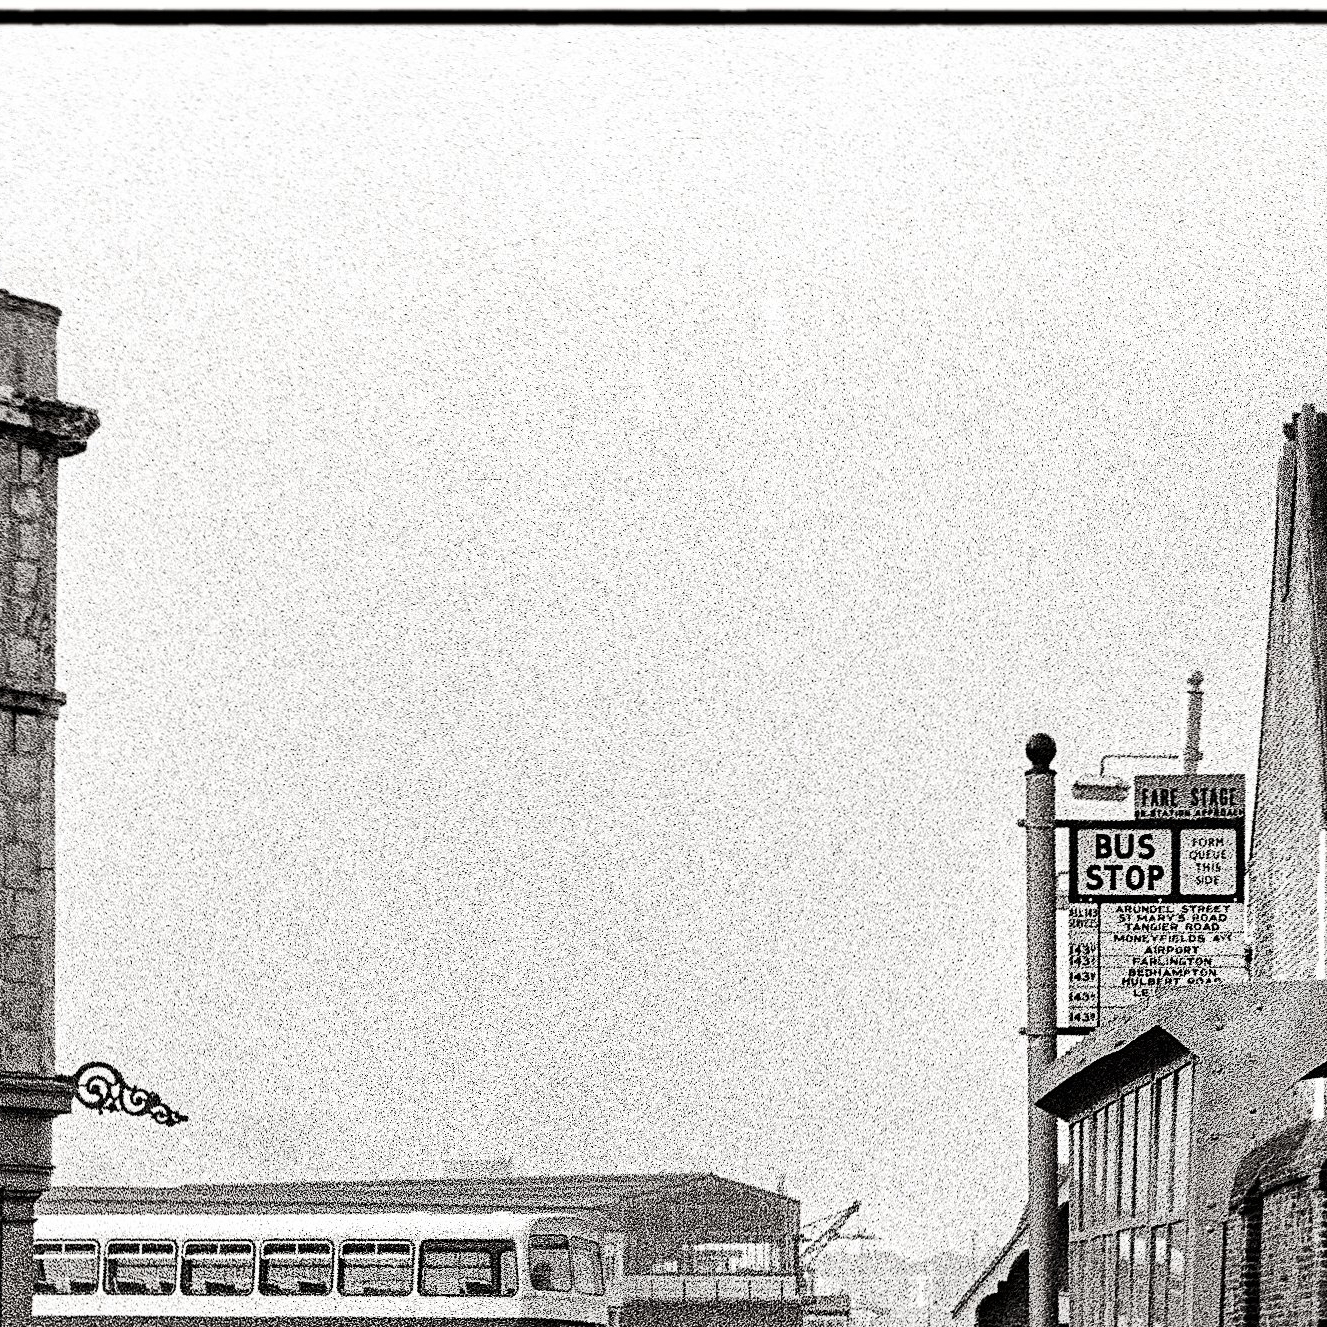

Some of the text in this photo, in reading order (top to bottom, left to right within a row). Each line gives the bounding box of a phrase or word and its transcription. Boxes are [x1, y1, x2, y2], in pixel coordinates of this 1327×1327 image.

[1141, 788, 1238, 807] FARE STAGE
[1095, 833, 1156, 860] BUS
[1192, 837, 1224, 848] FORM
[1189, 850, 1228, 861] QUEUE
[1195, 863, 1222, 873] THIS
[1085, 864, 1165, 891] STOP
[1195, 876, 1221, 886] SIDE
[1116, 905, 1231, 914] ARUNDEL STREET
[1192, 914, 1228, 923] ROAD
[1125, 923, 1221, 932] TANGIER ROAD
[1144, 946, 1200, 955] AIRPORT
[1132, 957, 1213, 966] FARLINGTON
[1128, 968, 1217, 977] BEDHAMPTON
[1121, 977, 1181, 986] HULBERT
